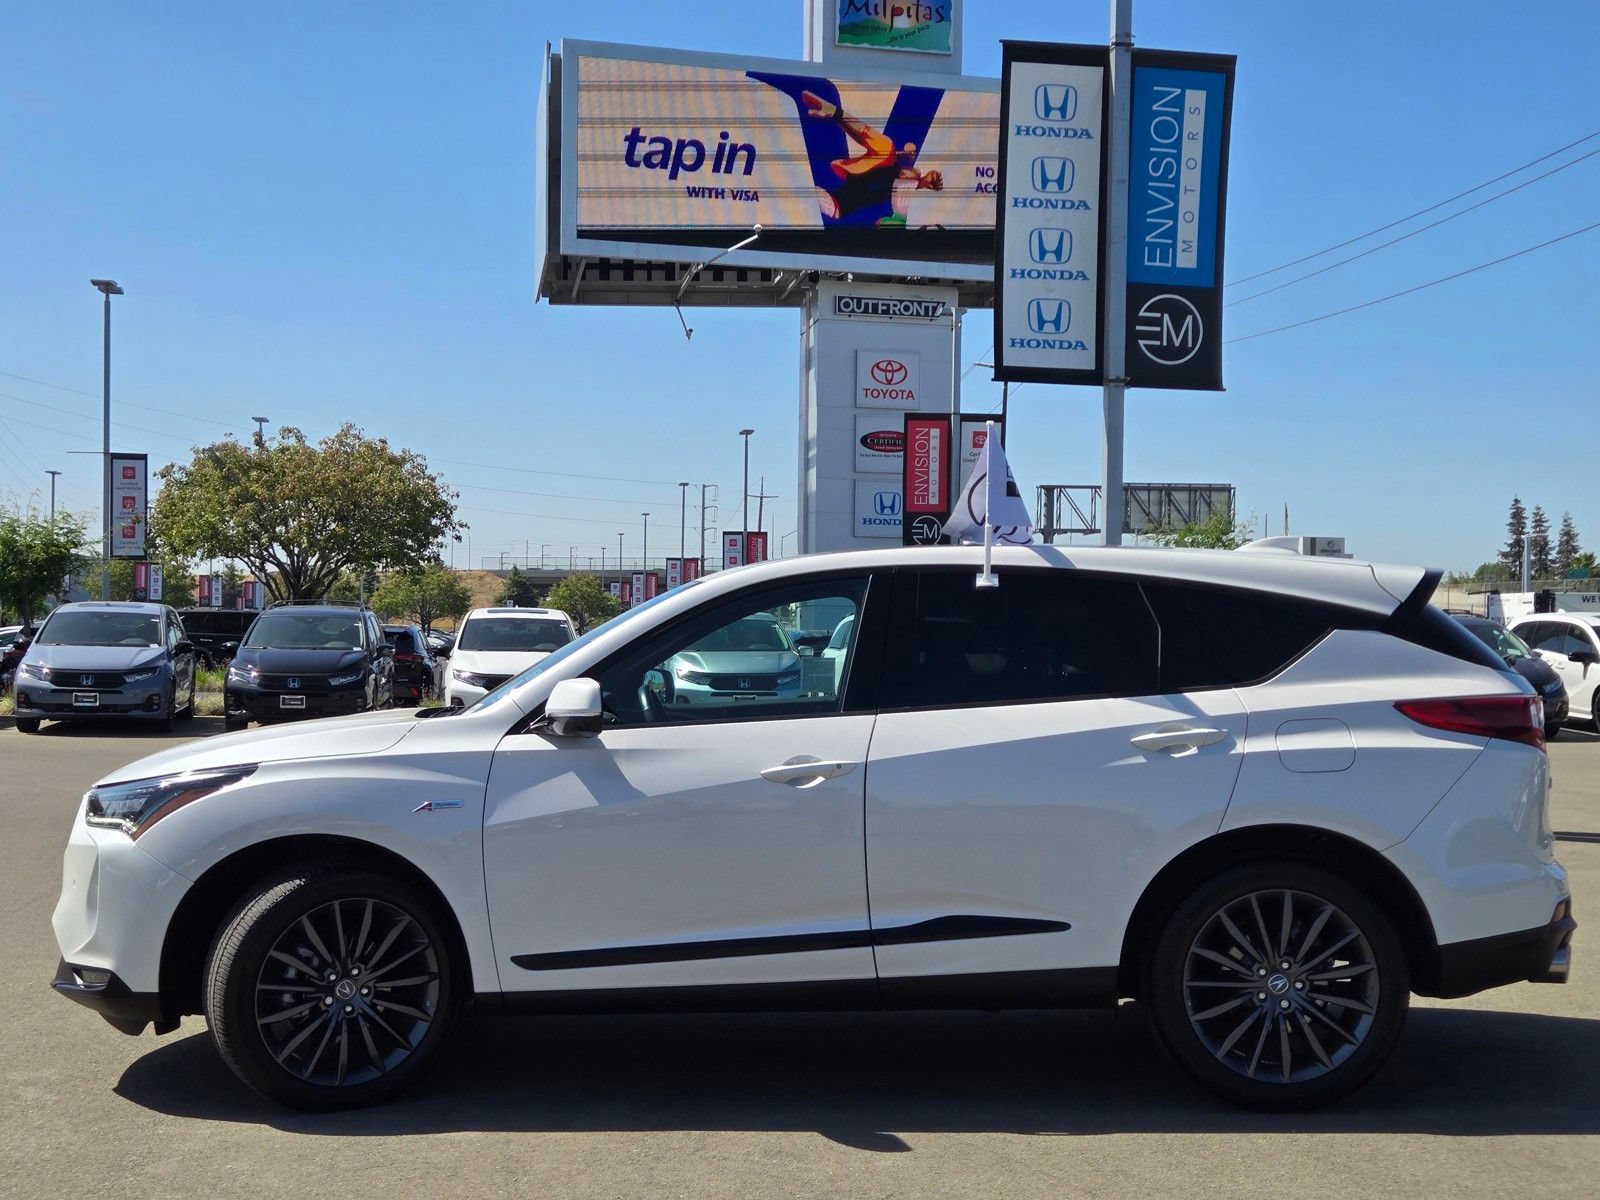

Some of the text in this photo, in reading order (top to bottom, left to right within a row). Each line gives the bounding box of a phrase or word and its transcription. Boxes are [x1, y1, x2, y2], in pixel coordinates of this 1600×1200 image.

[1015, 125, 1094, 139] HONDA
[624, 127, 757, 180] tap in
[975, 167, 995, 178] NO
[1144, 86, 1182, 267] ENVISION
[1181, 106, 1201, 253] MOTORS
[686, 186, 760, 202] WITH VISA
[1012, 197, 1092, 210] HONDA
[1009, 268, 1090, 281] HONDA
[839, 298, 937, 316] OUTFRONT
[1009, 338, 1088, 351] HONDA
[862, 388, 915, 401] TOYOTA
[914, 427, 929, 505] ENVISION
[862, 517, 902, 526] HOND
